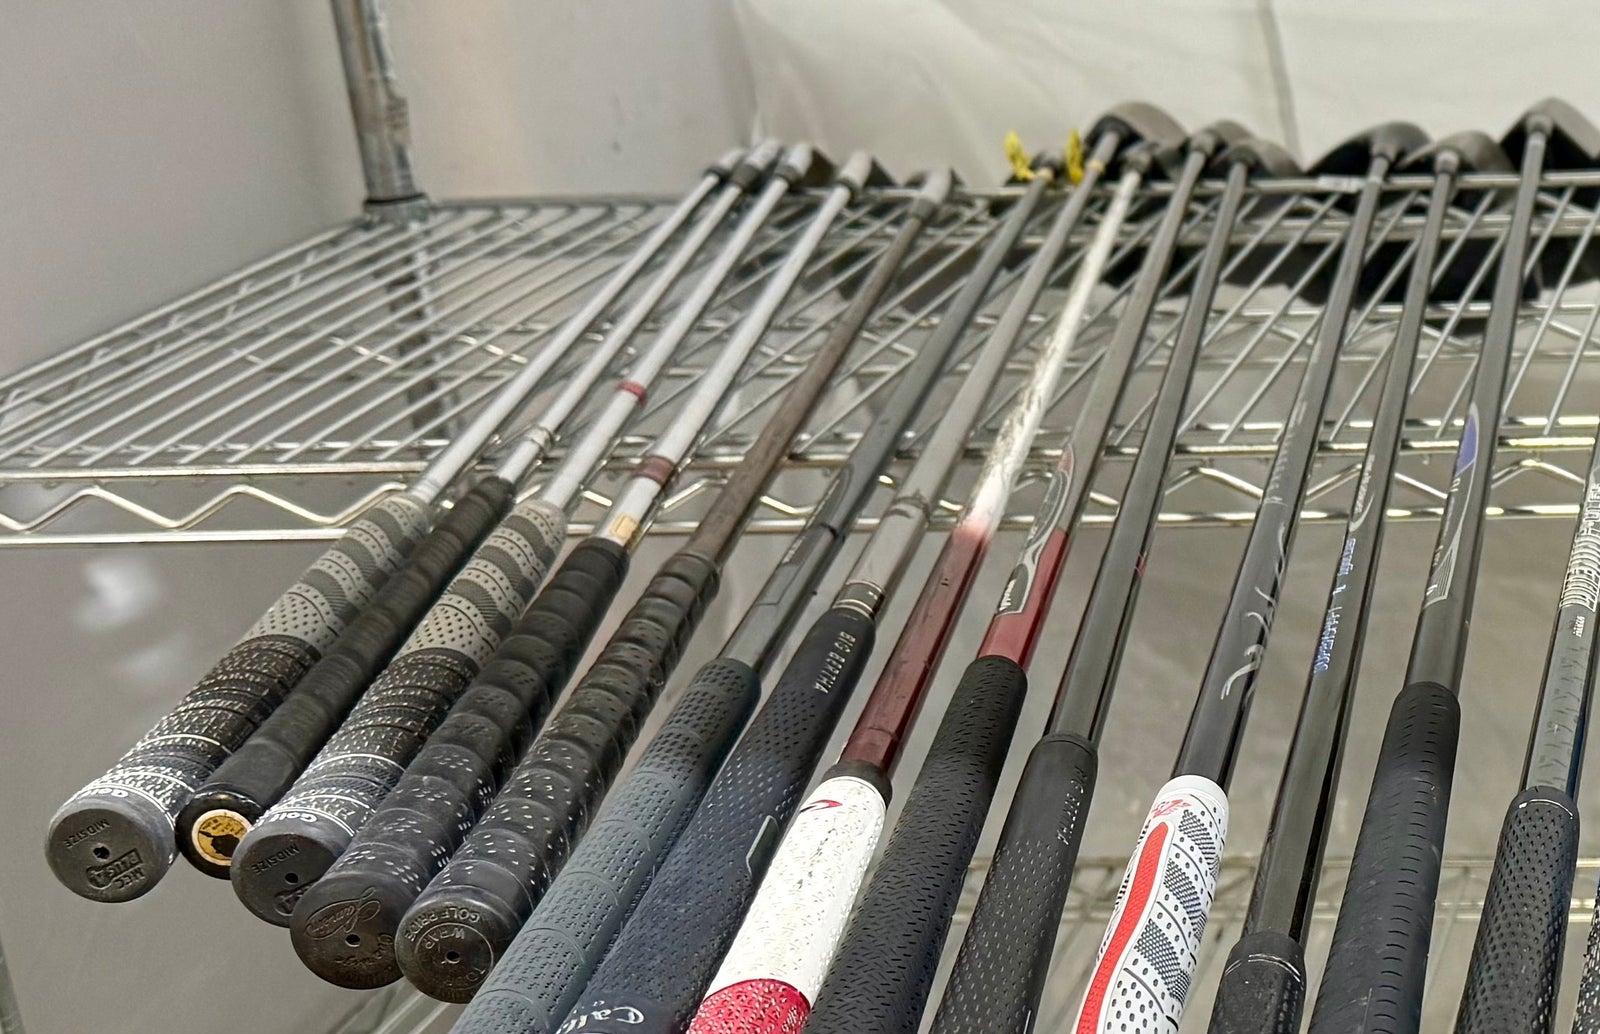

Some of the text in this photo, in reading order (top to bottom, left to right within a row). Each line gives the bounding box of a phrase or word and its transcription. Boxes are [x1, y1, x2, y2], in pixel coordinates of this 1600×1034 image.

[62, 818, 111, 848] MIDSIZE
[250, 843, 300, 874] MIDSIZE
[403, 907, 480, 942] GOLF PRIDE
